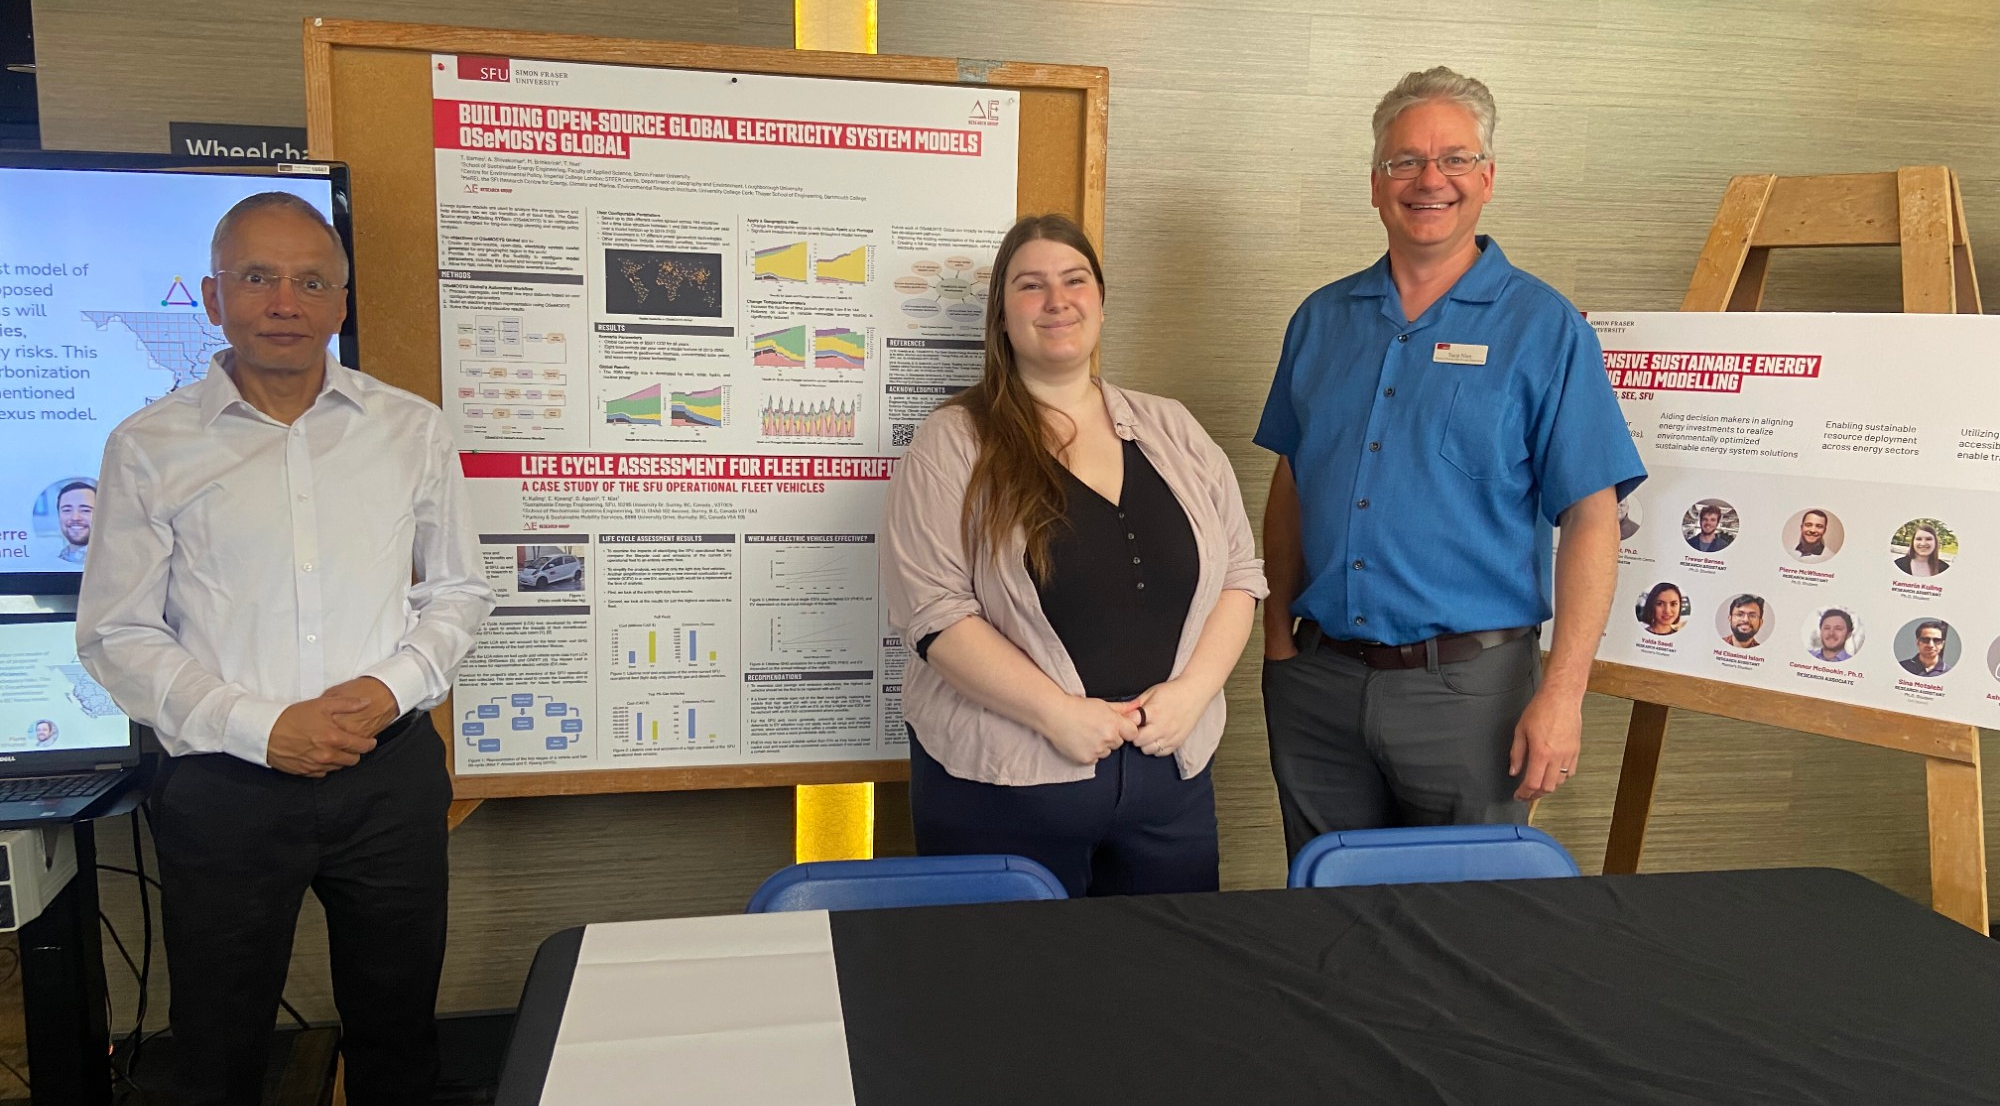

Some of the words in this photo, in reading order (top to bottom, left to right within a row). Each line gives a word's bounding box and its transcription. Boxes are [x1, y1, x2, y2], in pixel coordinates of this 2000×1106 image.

[480, 68, 508, 81] SFU
[540, 71, 568, 79] FRASER
[515, 78, 559, 86] UNIVERSITY
[459, 104, 542, 129] BUILDING
[548, 108, 666, 136] OPEN-SOURCE
[670, 116, 732, 140] GLOBAL
[737, 120, 842, 146] ELECTRICITY
[846, 128, 911, 149] SYSTEM
[915, 131, 978, 153] MODELS
[460, 128, 557, 152] OSeMOSYS
[560, 133, 626, 156] GLOBAL
[15, 263, 68, 276] model
[72, 264, 89, 276] of
[442, 270, 472, 279] METHODS
[15, 304, 47, 317] will
[15, 345, 58, 358] risks.
[61, 346, 98, 358] This
[1650, 355, 1752, 373] SUSTAINABLE
[1754, 356, 1818, 375] ENERGY
[1623, 370, 1652, 387] AND
[1654, 372, 1739, 391] MODELLING
[1621, 392, 1636, 400] SEE,
[1639, 392, 1654, 400] SFU
[41, 408, 97, 420] model.
[1661, 412, 1684, 422] Aiding
[1686, 414, 1719, 422] decision
[1720, 416, 1750, 424] makers
[1761, 417, 1794, 427] aligning
[1659, 422, 1684, 432] energy
[1686, 424, 1734, 433] investments
[1746, 426, 1773, 436] realize
[1825, 420, 1863, 432] Enabling
[1864, 423, 1916, 434] sustainable
[1657, 433, 1718, 444] environmentally
[1720, 436, 1760, 446] optimized
[1824, 432, 1862, 441] resource
[1864, 434, 1917, 444] deployment
[1961, 428, 2000, 440] Utilizing
[1656, 442, 1698, 452] sustainable
[1700, 446, 1728, 455] energy
[1728, 446, 1758, 456] system
[1760, 448, 1798, 458] solutions
[1822, 443, 1851, 451] across
[1853, 444, 1883, 454] energy
[1884, 446, 1919, 456] sectors
[1957, 452, 1988, 460] enable
[521, 456, 558, 476] LIFE
[562, 456, 614, 476] CYCLE
[618, 457, 726, 476] ASSESSMENT
[730, 458, 762, 476] FOR
[764, 458, 811, 476] FLEET
[522, 482, 528, 492] A
[532, 482, 560, 492] CASE
[564, 482, 598, 492] STUDY
[603, 482, 615, 492] OF
[619, 482, 640, 492] THE
[644, 482, 662, 492] SFU
[666, 482, 738, 492] OPERATIONAL
[742, 482, 772, 492] FLEET
[776, 483, 825, 493] VEHICLES
[1684, 555, 1704, 563] Trevor
[1779, 566, 1798, 575] Pierre
[1798, 568, 1834, 579] McWhannel
[1892, 580, 1920, 590] Kamaria
[1921, 584, 1942, 593] Kuling
[1642, 637, 1657, 646] Yalda
[1748, 654, 1764, 662] Islam
[1790, 662, 1812, 670] Connor
[1898, 679, 1914, 688] Sina
